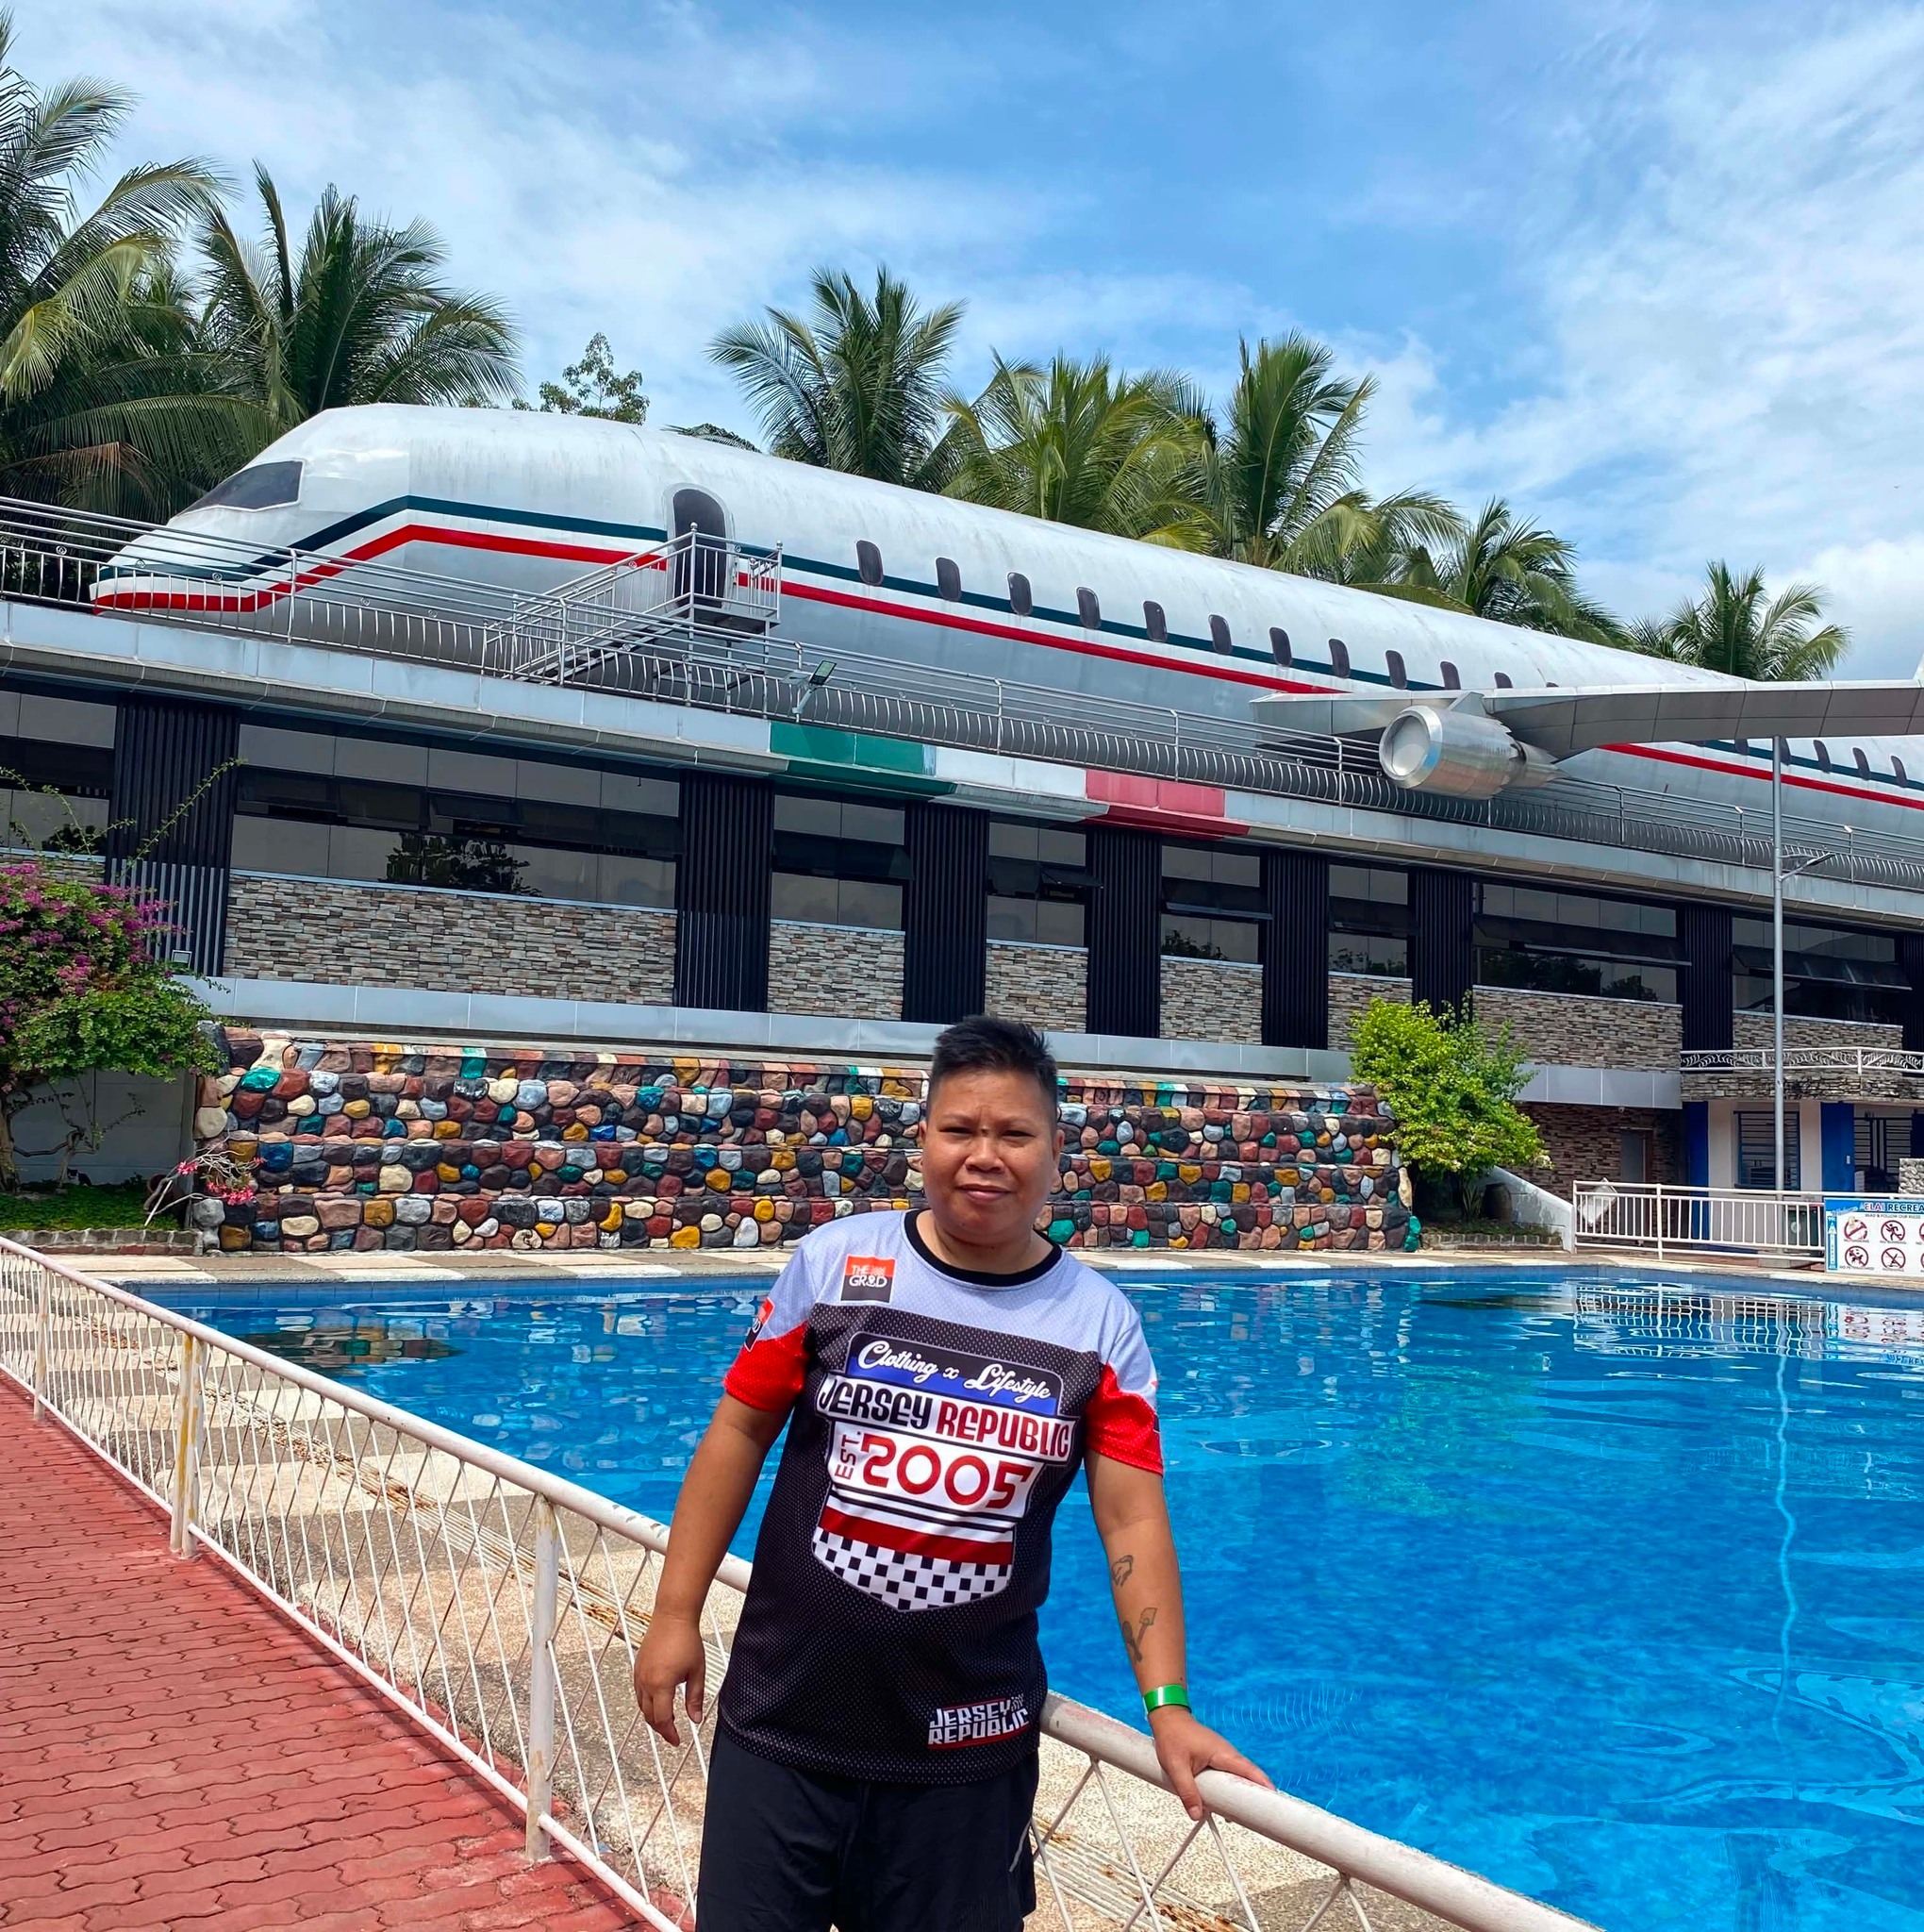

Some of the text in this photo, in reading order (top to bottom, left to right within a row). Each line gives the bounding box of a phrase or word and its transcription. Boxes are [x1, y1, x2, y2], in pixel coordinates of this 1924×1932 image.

[852, 1264, 871, 1275] THE
[857, 1341, 938, 1384] Clothing
[964, 1363, 1051, 1404] Lifestyle
[819, 1378, 1070, 1458] JERSEY REPUBLIC
[860, 1432, 1037, 1508] 2005
[927, 1708, 1030, 1745] REPUBLIC
[929, 1699, 1011, 1728] JERSEY
